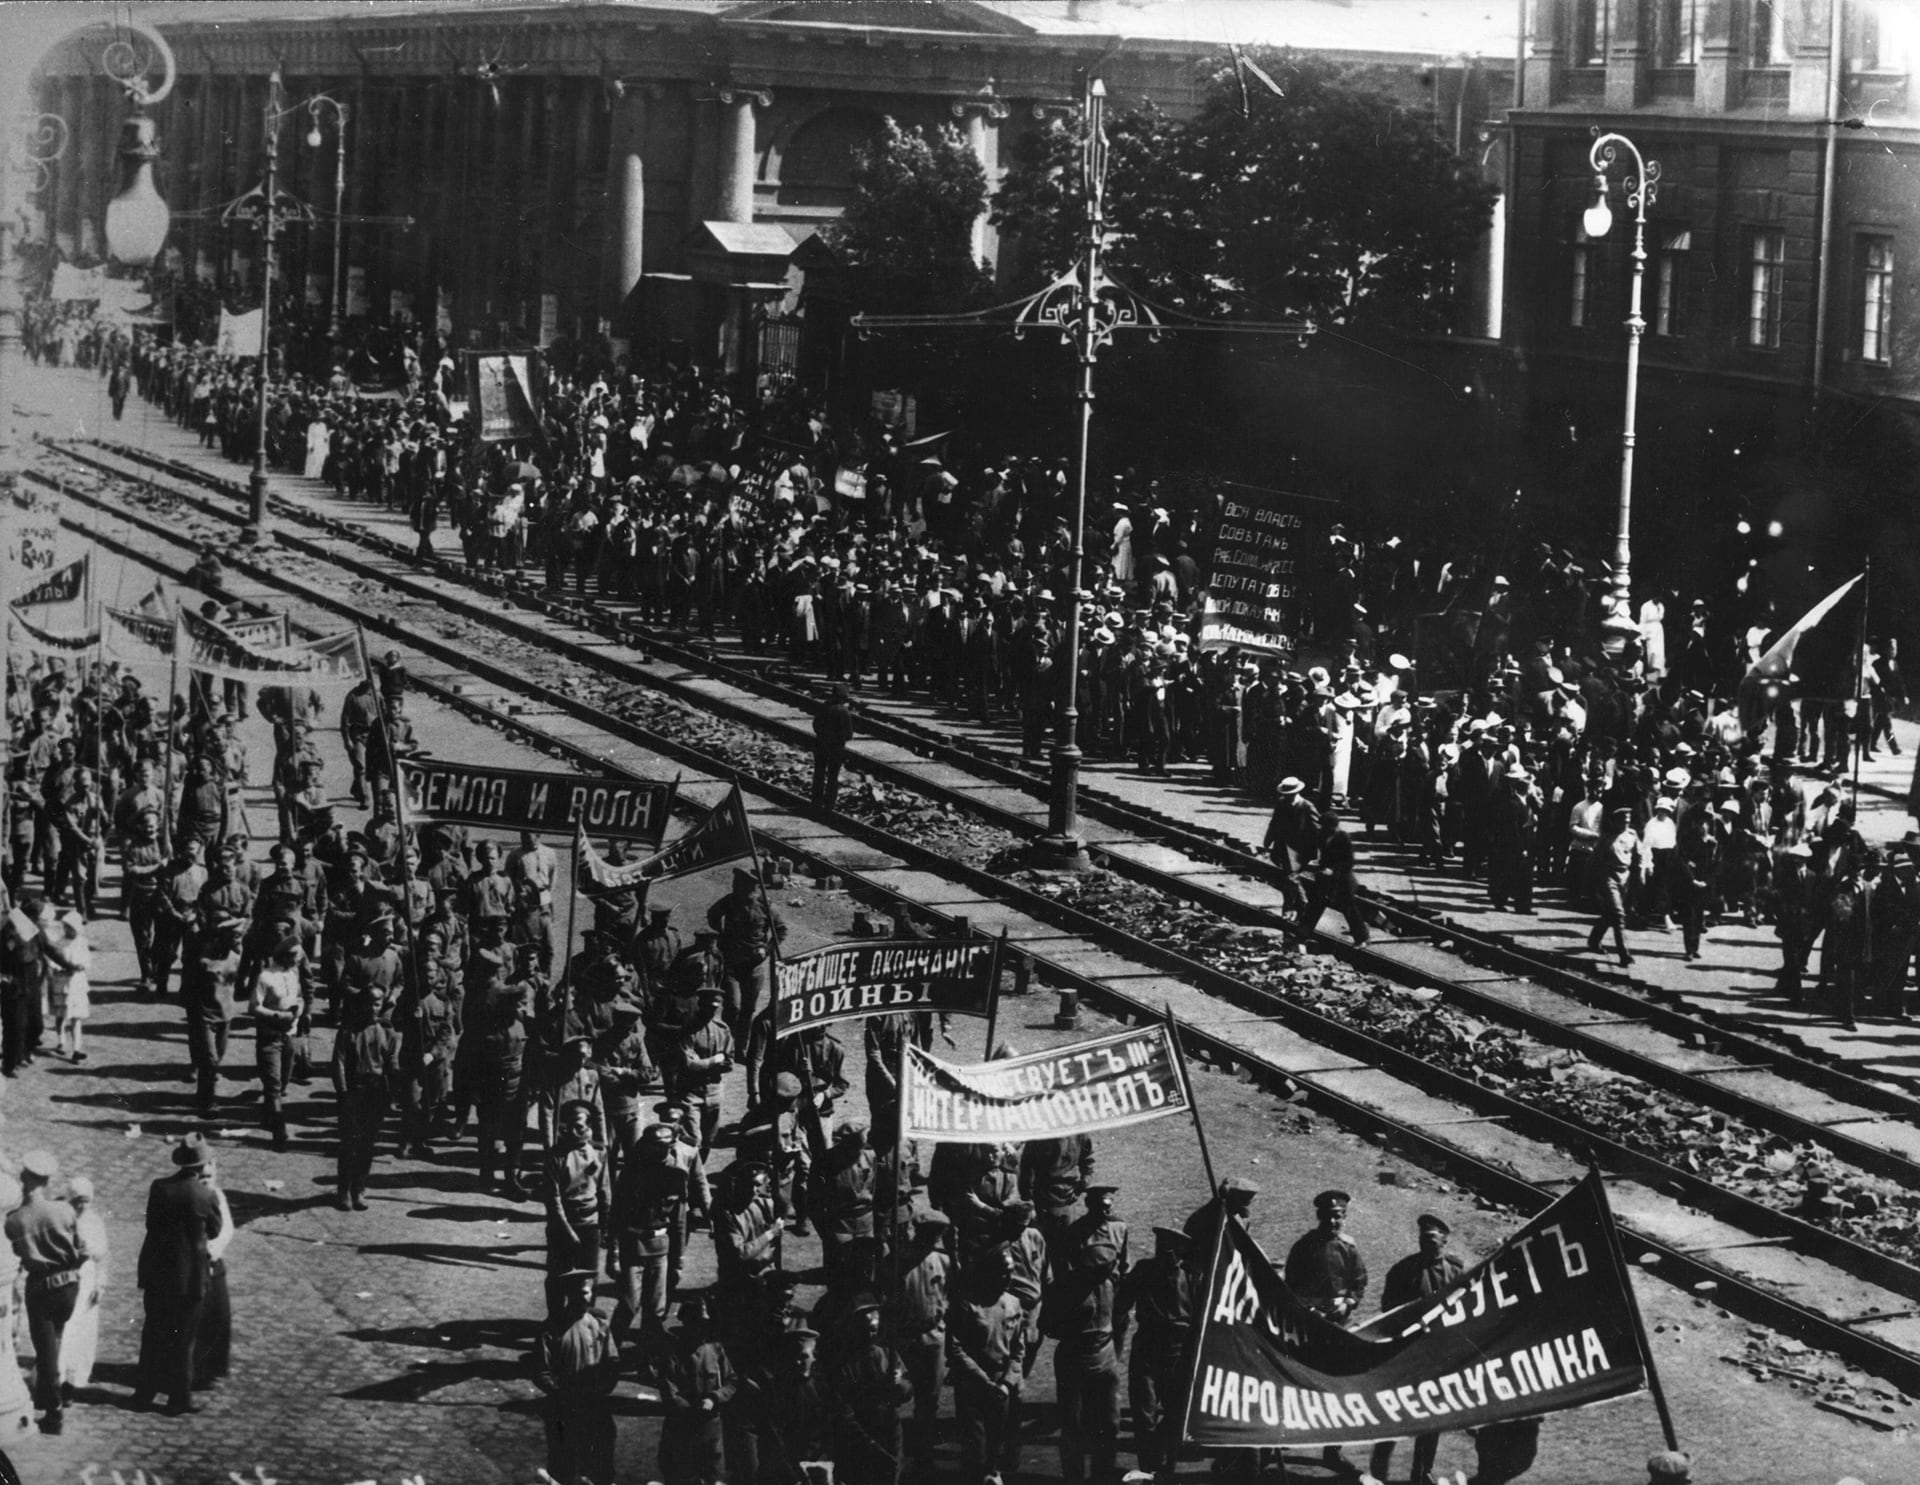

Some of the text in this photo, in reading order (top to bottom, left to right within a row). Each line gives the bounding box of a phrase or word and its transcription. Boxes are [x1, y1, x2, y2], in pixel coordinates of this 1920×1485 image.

[1225, 502, 1301, 528] ВСЯ ВЛАСТЬ
[408, 771, 651, 829] ЗЕМЛЯ И ВОЛЯ
[789, 982, 932, 1023] ВОЙНЫ
[1201, 1327, 1611, 1430] НАРОДНАЯ РЕСПУБЛИКА
